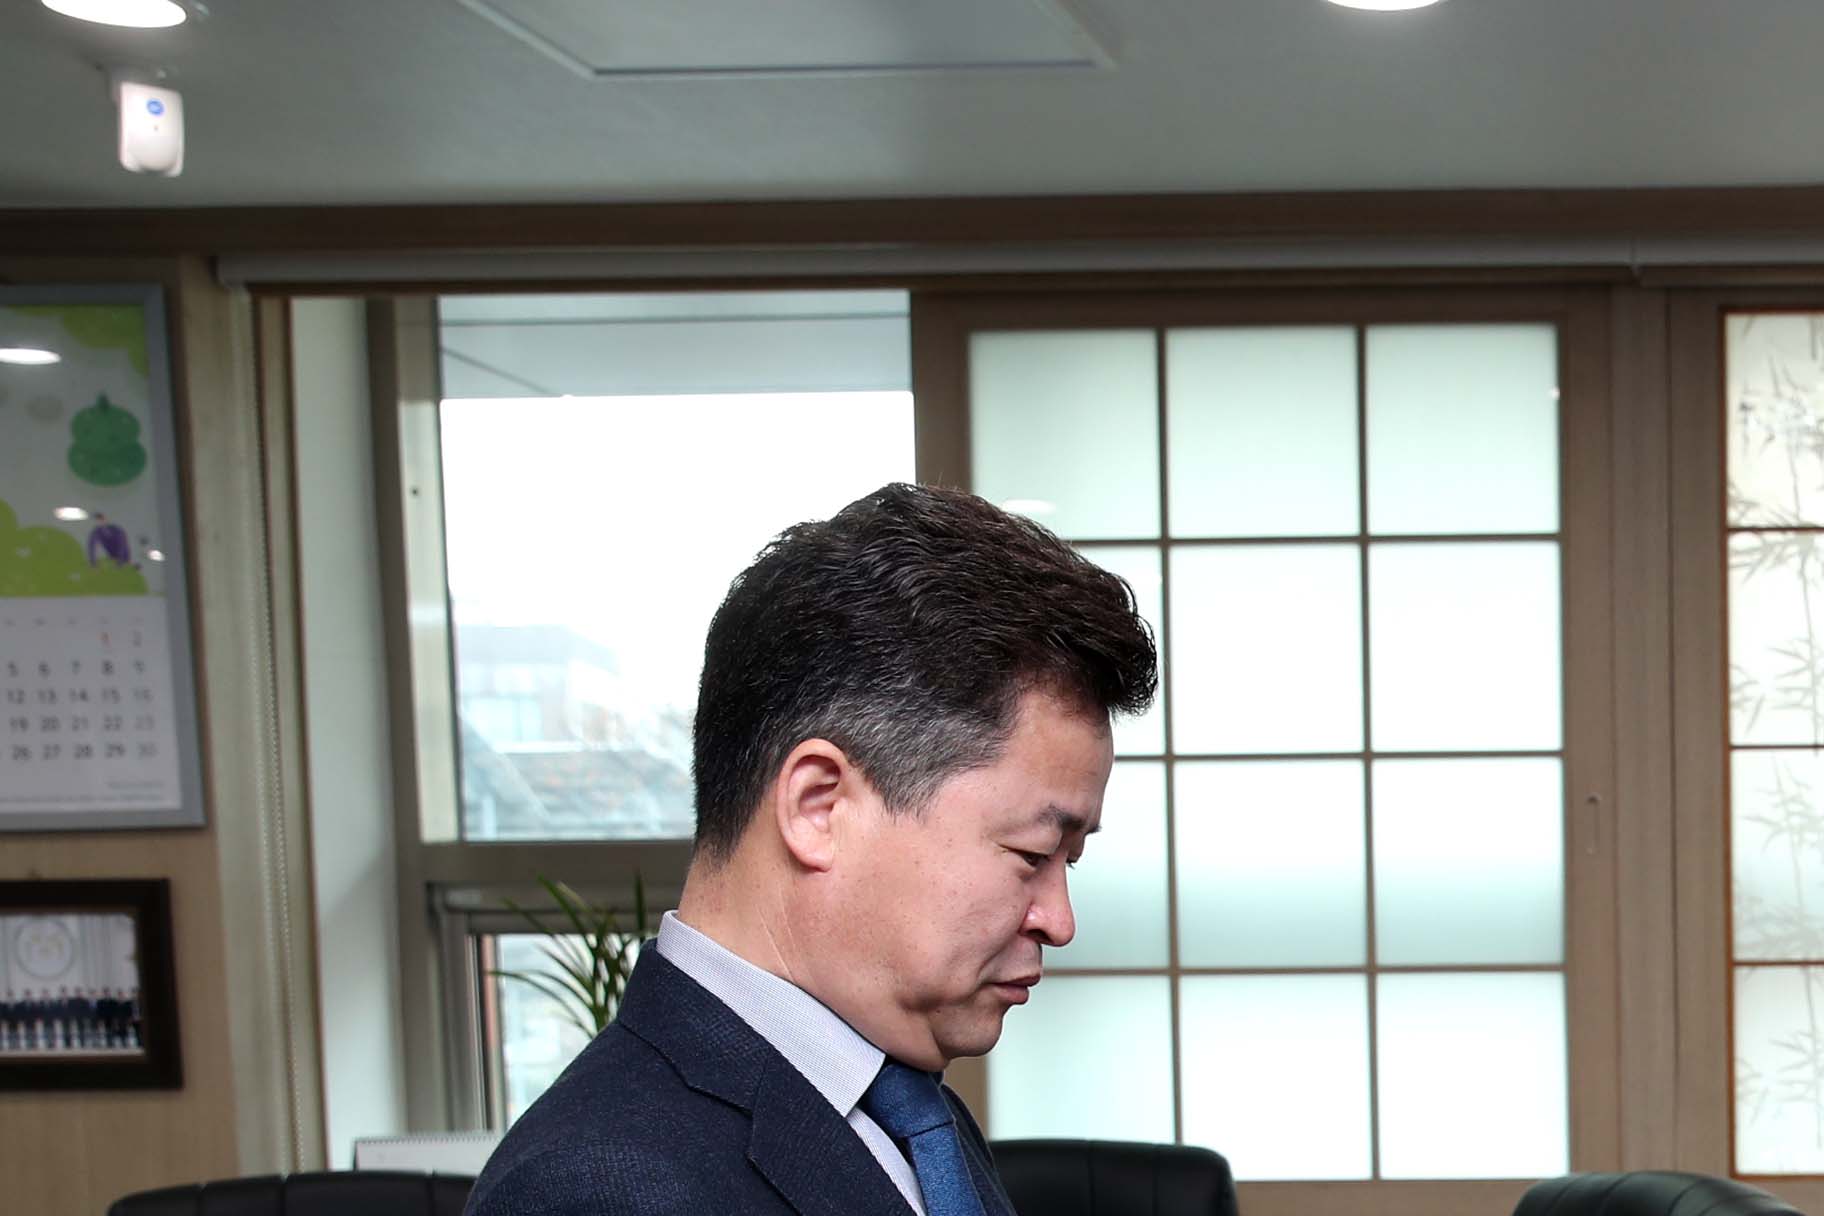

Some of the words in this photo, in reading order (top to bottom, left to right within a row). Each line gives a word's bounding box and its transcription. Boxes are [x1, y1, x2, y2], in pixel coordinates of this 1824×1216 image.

[8, 661, 18, 677] 5
[38, 661, 50, 678] 6
[71, 660, 81, 675] 7
[102, 660, 114, 676] 8
[7, 688, 25, 704] 12
[37, 688, 57, 704] 13
[70, 688, 88, 703] 14
[102, 688, 120, 704] 15
[9, 716, 29, 732] 19
[41, 716, 60, 732] 20
[72, 715, 89, 732] 21
[104, 715, 123, 731] 22
[12, 745, 31, 761] 26
[43, 744, 61, 760] 27
[74, 744, 93, 759] 28
[105, 743, 125, 759] 29
